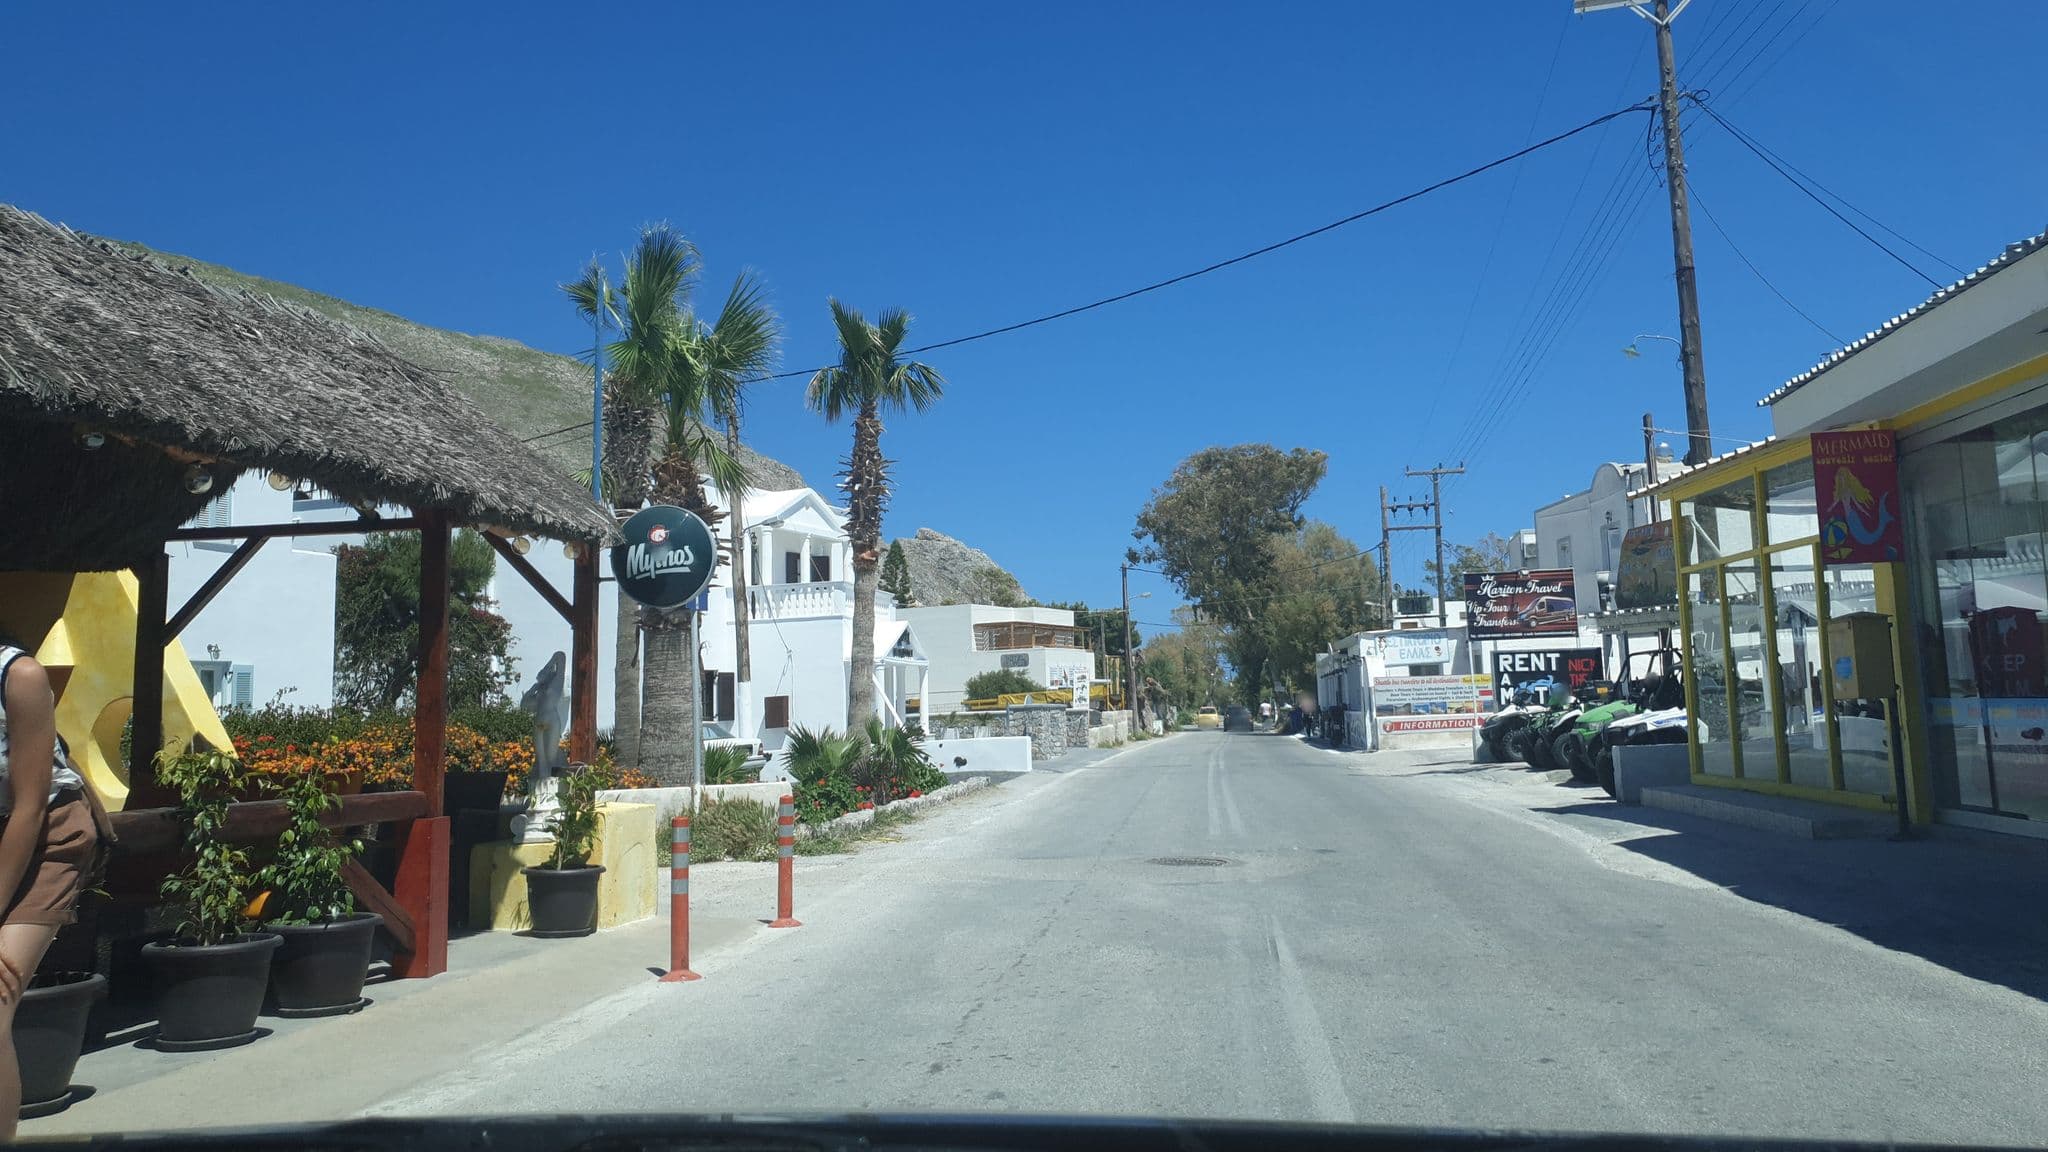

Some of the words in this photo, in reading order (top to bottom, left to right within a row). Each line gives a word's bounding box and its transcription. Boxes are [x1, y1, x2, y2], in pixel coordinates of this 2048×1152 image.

[1816, 433, 1891, 455] MERMAID
[626, 543, 694, 579] Myhos
[1477, 580, 1524, 599] Hariton
[1524, 579, 1562, 593] Travel
[1466, 600, 1483, 617] Vip
[1499, 653, 1561, 672] RENT
[1983, 653, 2026, 672] KEP
[1501, 673, 1511, 686] A
[1400, 719, 1473, 731] INFORMATION
